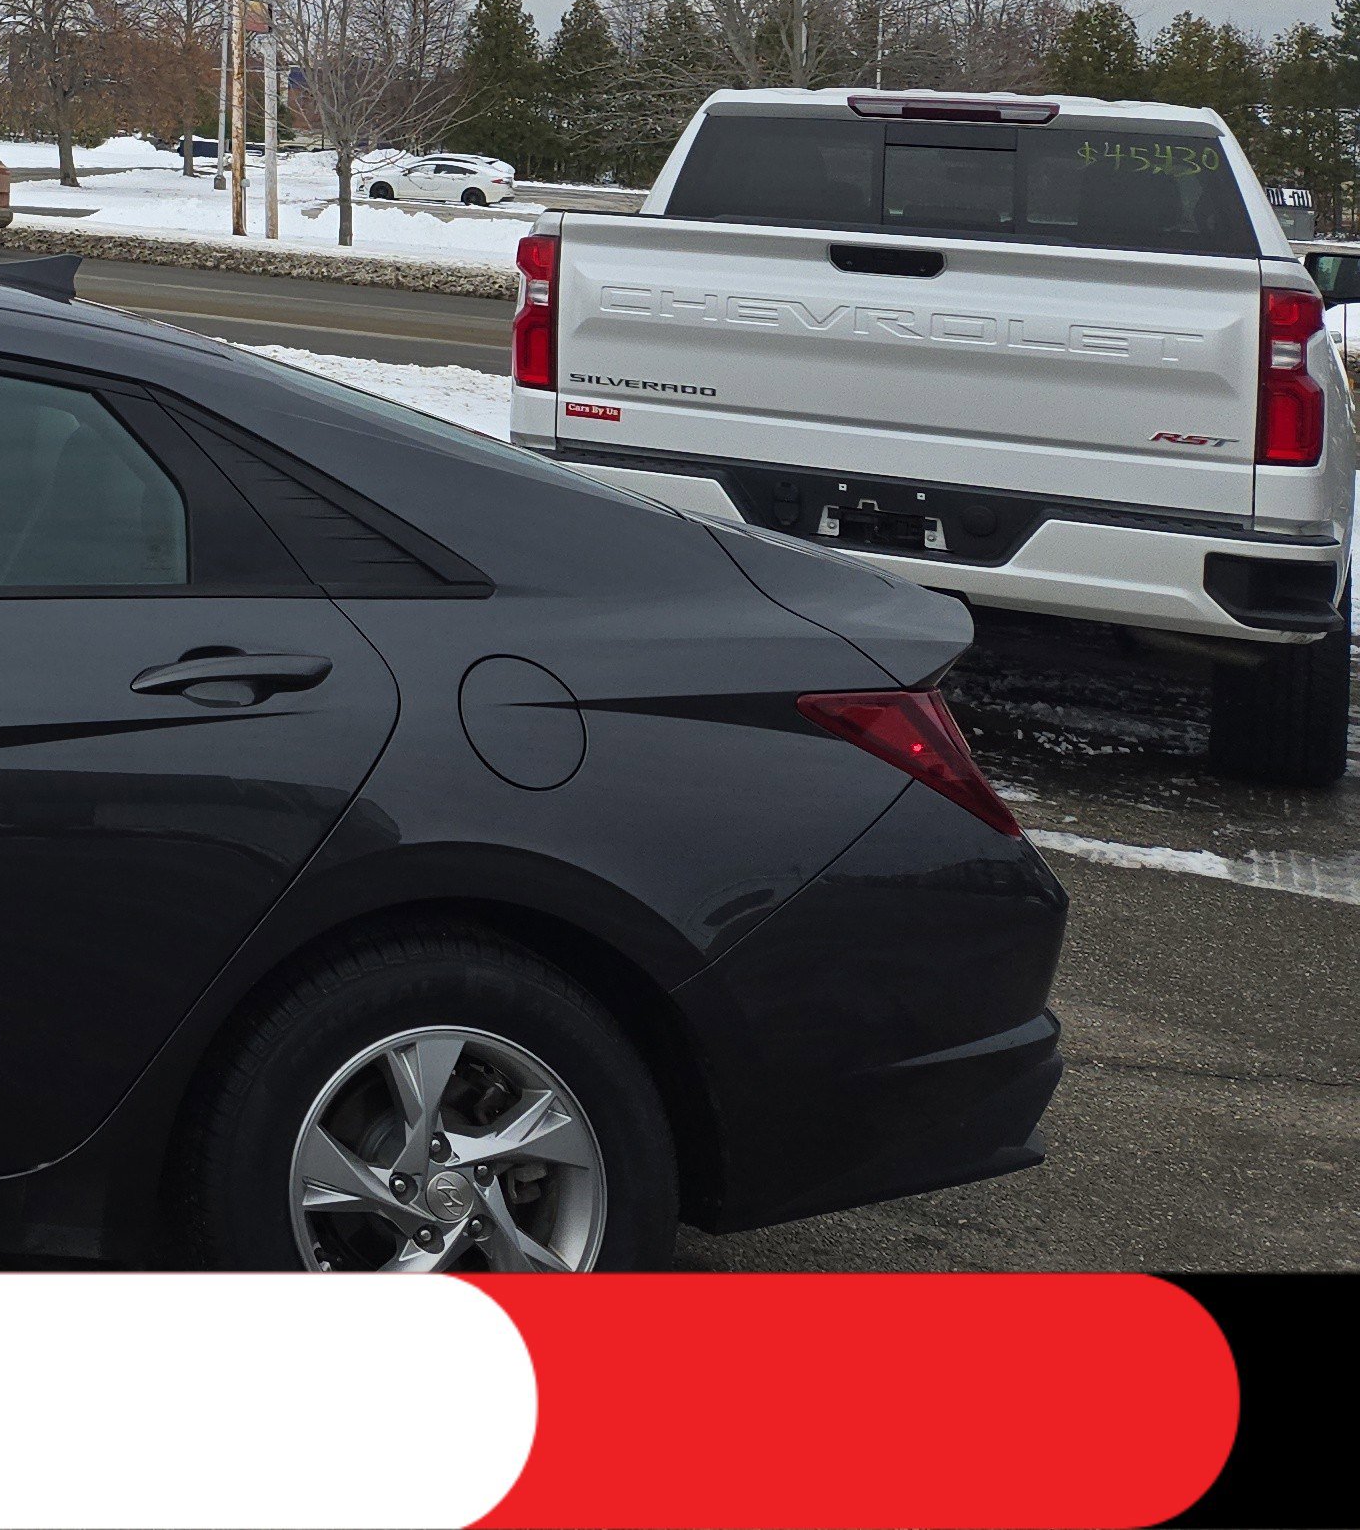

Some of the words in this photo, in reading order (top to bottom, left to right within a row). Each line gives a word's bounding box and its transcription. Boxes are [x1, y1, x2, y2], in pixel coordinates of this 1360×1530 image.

[1076, 141, 1220, 177] $45,430
[599, 285, 1204, 362] CHEVROLET
[569, 372, 717, 397] SILVERADO
[568, 402, 590, 413] Cars
[592, 405, 605, 416] By
[606, 408, 619, 416] Us
[1147, 431, 1240, 448] RST
